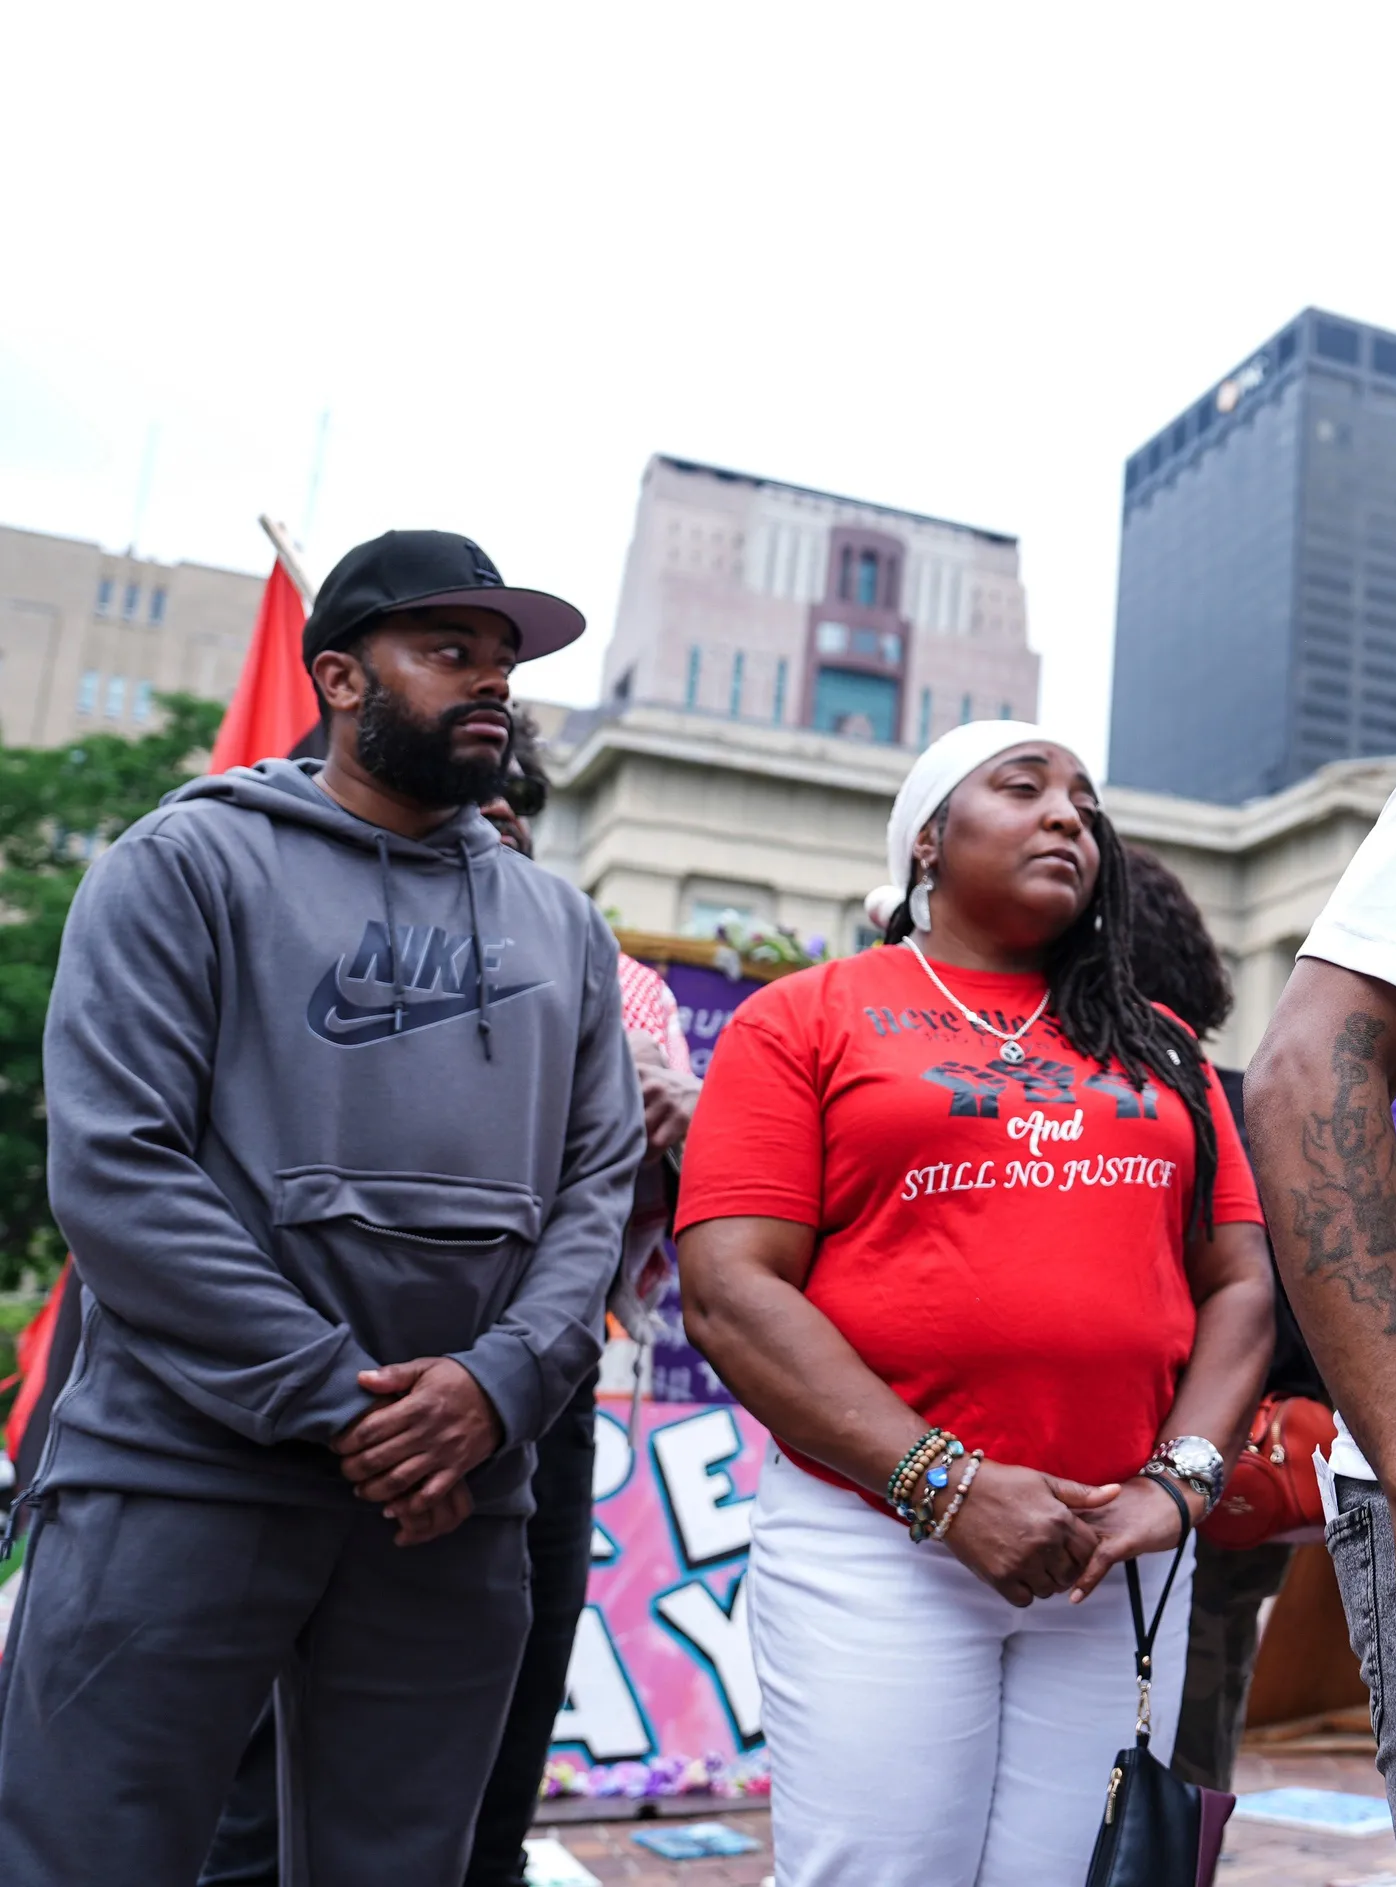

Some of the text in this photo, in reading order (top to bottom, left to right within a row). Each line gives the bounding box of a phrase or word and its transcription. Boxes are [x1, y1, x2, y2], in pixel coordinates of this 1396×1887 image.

[345, 919, 506, 998] NIKE
[863, 1006, 962, 1037] Here
[1006, 1108, 1084, 1157] And
[900, 1154, 1177, 1201] STILL NO JUSTICE
